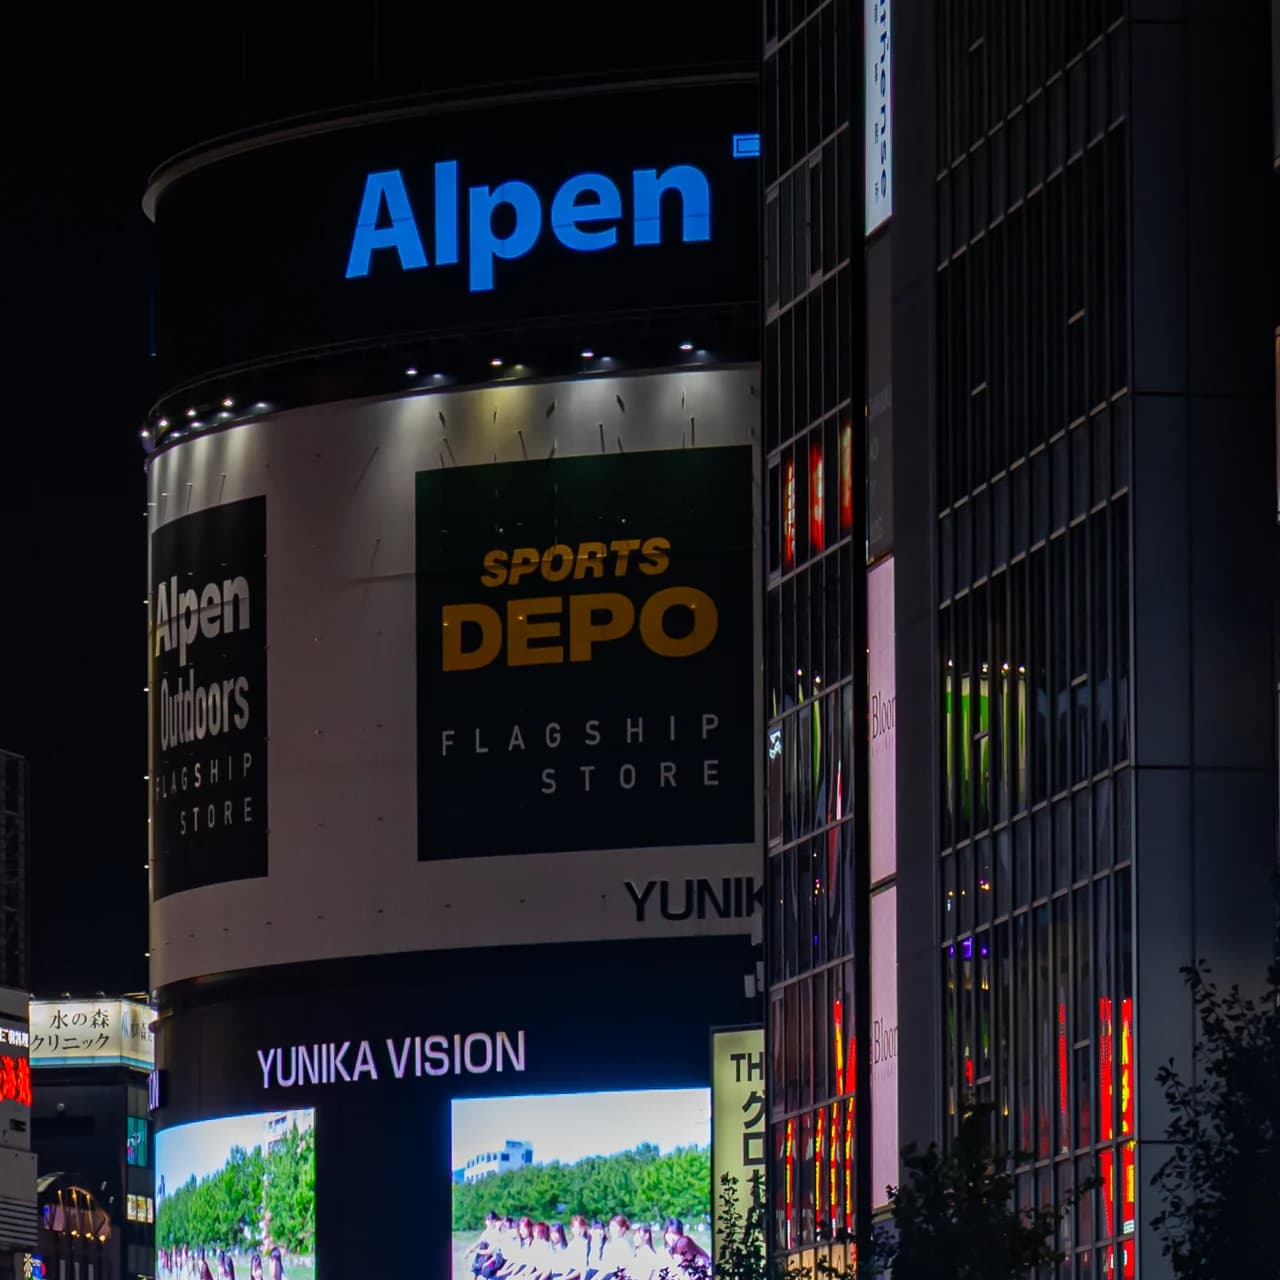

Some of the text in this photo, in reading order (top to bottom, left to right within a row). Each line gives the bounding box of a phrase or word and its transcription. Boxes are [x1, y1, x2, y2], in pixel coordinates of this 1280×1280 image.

[345, 159, 712, 292] Alpen
[480, 535, 671, 589] SPORTS
[154, 574, 251, 666] Alpen
[441, 586, 719, 672] DEPO
[159, 674, 250, 752] Outdoors
[441, 713, 720, 758] FLAGSHIP
[540, 758, 720, 795] STORE
[179, 796, 254, 836] STORE
[31, 1033, 110, 1053] クリニック
[49, 1008, 110, 1030] 水の森
[258, 1030, 526, 1088] YUNIKA VISION
